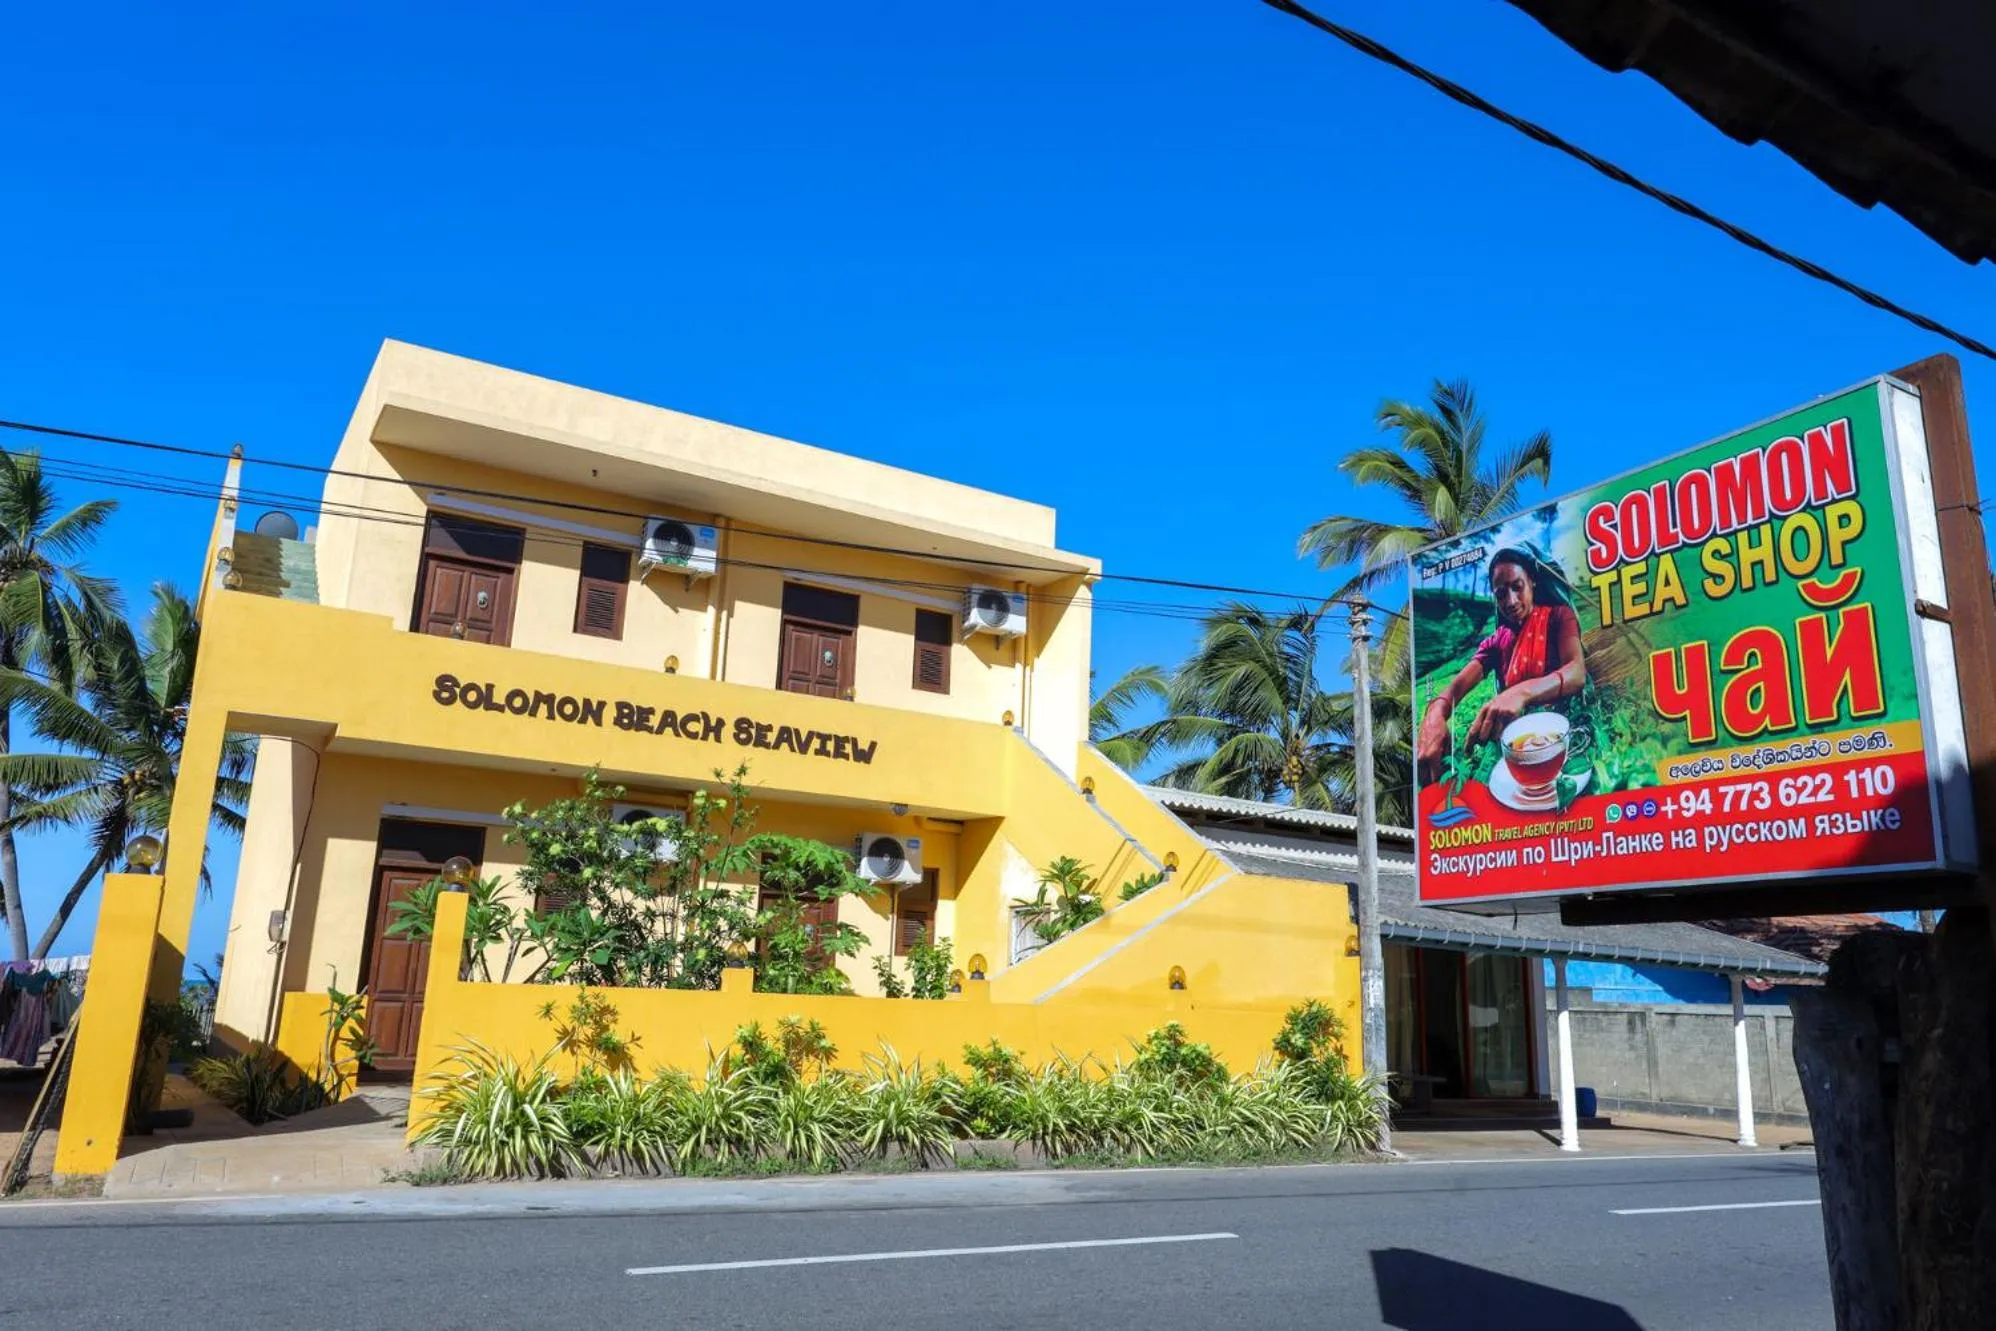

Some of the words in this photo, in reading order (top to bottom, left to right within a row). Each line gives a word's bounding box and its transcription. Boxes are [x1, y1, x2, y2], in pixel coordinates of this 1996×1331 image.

[1585, 418, 1856, 571] SOLOMON
[1591, 552, 1687, 627] TEA
[1701, 499, 1863, 598] SHOP
[431, 673, 608, 727] SOLOMON
[613, 700, 726, 743] BEACH
[733, 716, 878, 765] SEAVIEW
[1661, 789, 1713, 818] +94
[1719, 781, 1771, 813] 773
[1778, 773, 1834, 807] 622
[1844, 765, 1895, 798] 110
[1429, 823, 1493, 850] SOLOMON
[1495, 826, 1522, 841] TRAVEL
[1523, 821, 1555, 838] AGENCY
[1579, 817, 1593, 831] LTD
[1430, 849, 1517, 877] Экскурсии
[1523, 843, 1545, 865] по
[1550, 832, 1664, 866] Шри-Ланке
[1671, 828, 1697, 850] на
[1704, 815, 1807, 852] русском
[1815, 807, 1901, 837] языке
